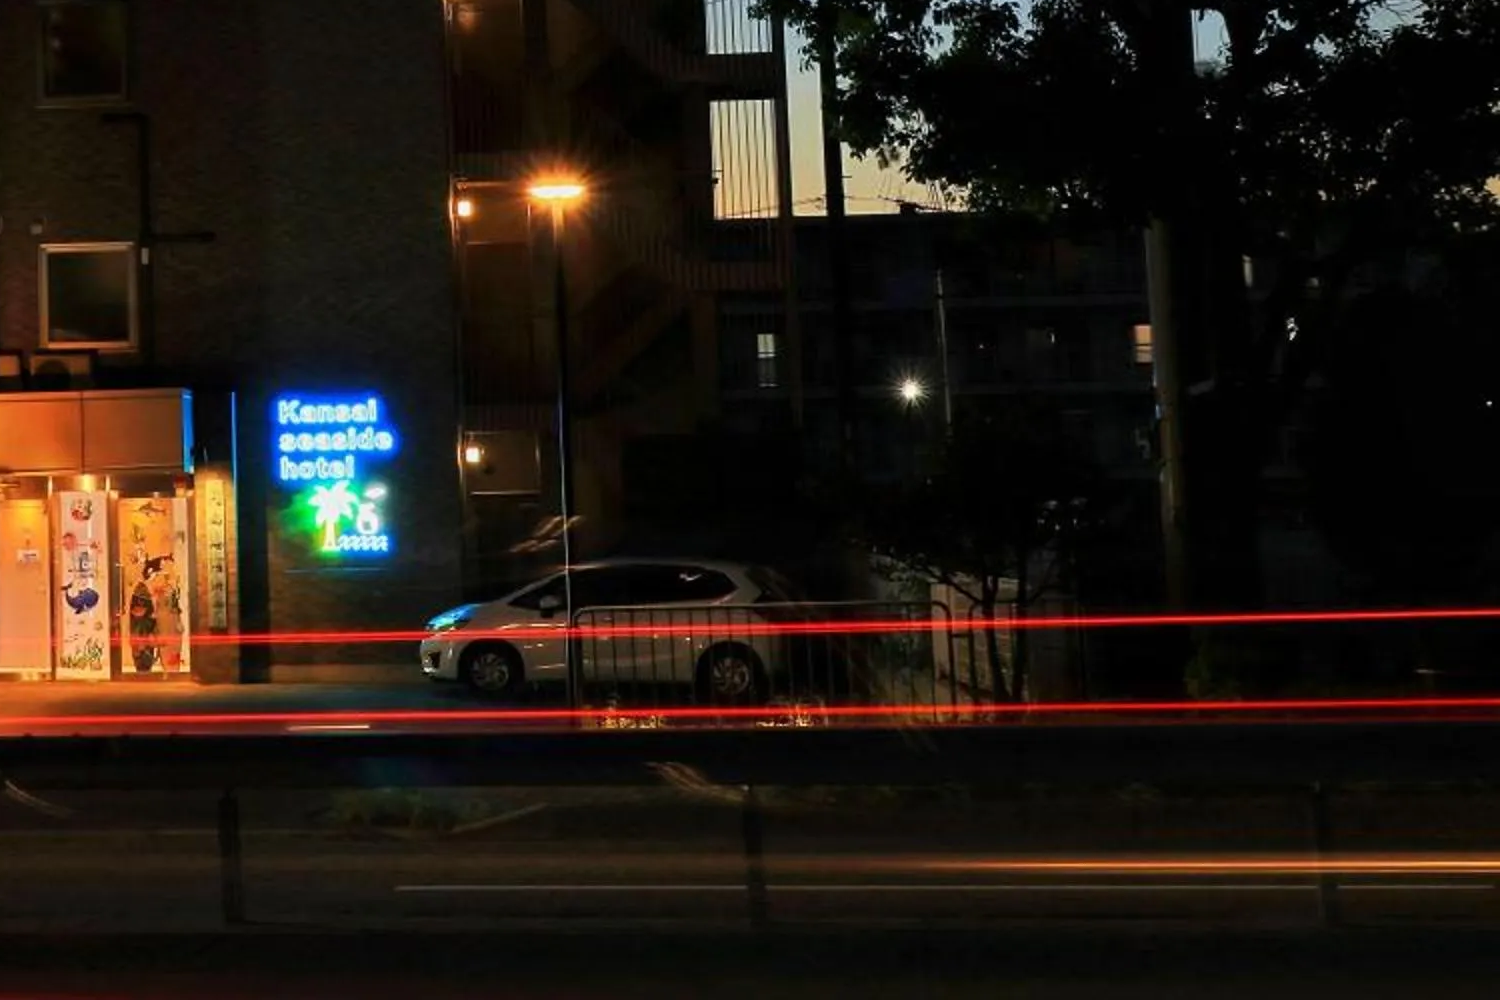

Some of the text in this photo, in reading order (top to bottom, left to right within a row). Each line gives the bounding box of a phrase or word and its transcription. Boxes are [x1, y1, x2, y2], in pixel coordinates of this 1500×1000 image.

[277, 397, 377, 424] Kansai
[278, 426, 393, 453] seaside
[279, 455, 355, 480] hotel
